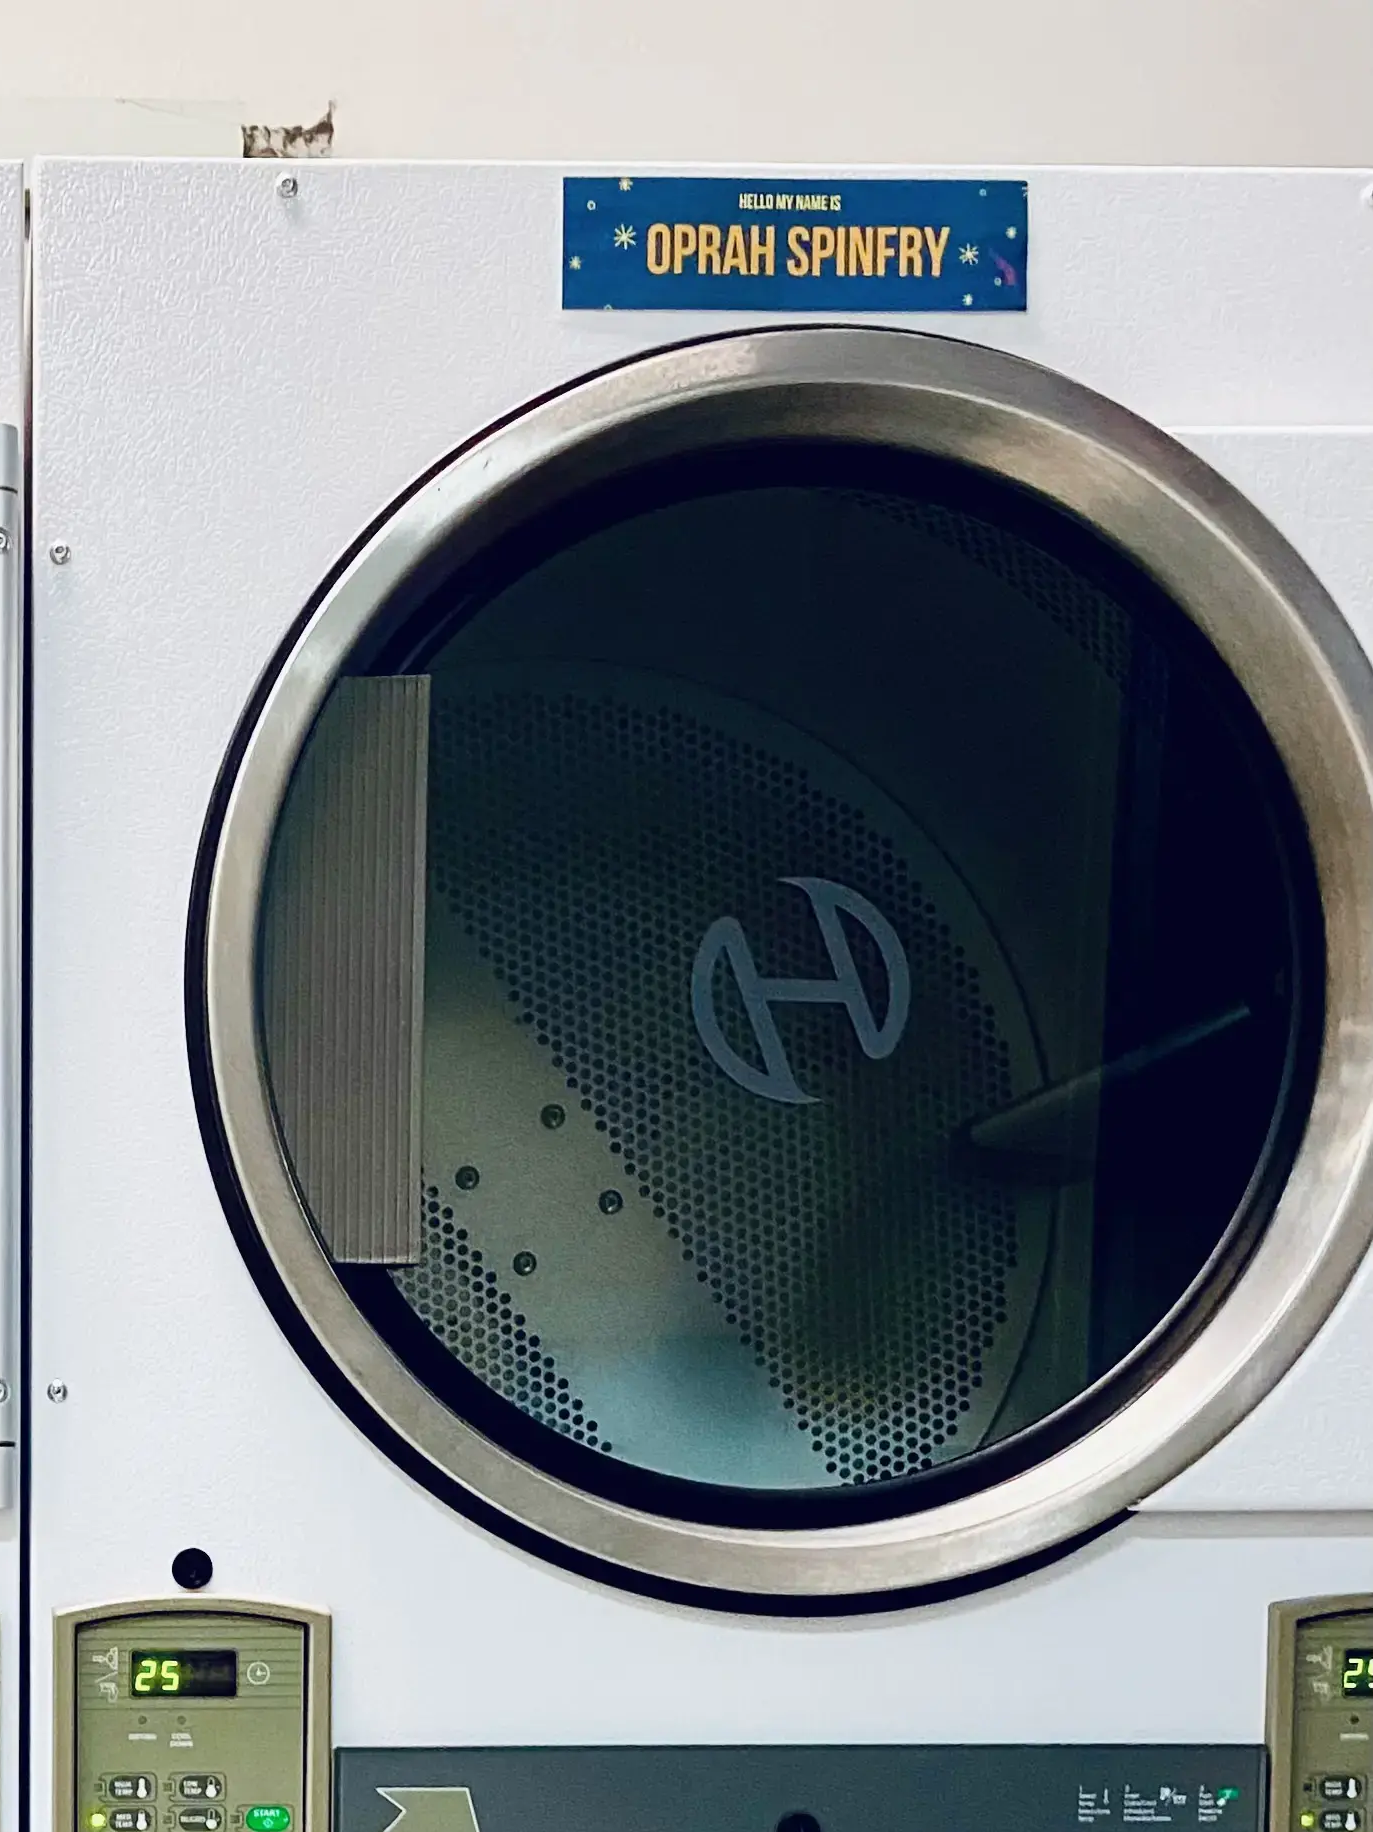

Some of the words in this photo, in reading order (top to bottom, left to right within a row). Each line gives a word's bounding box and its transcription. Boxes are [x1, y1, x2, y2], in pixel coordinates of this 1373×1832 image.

[739, 193, 774, 210] HELLO
[776, 194, 794, 211] MY
[795, 194, 828, 211] NAME
[830, 195, 842, 211] IS
[646, 222, 776, 277] OPRAH
[786, 225, 951, 279] SPINFRY
[134, 1660, 180, 1692] 25
[253, 1808, 280, 1818] START
